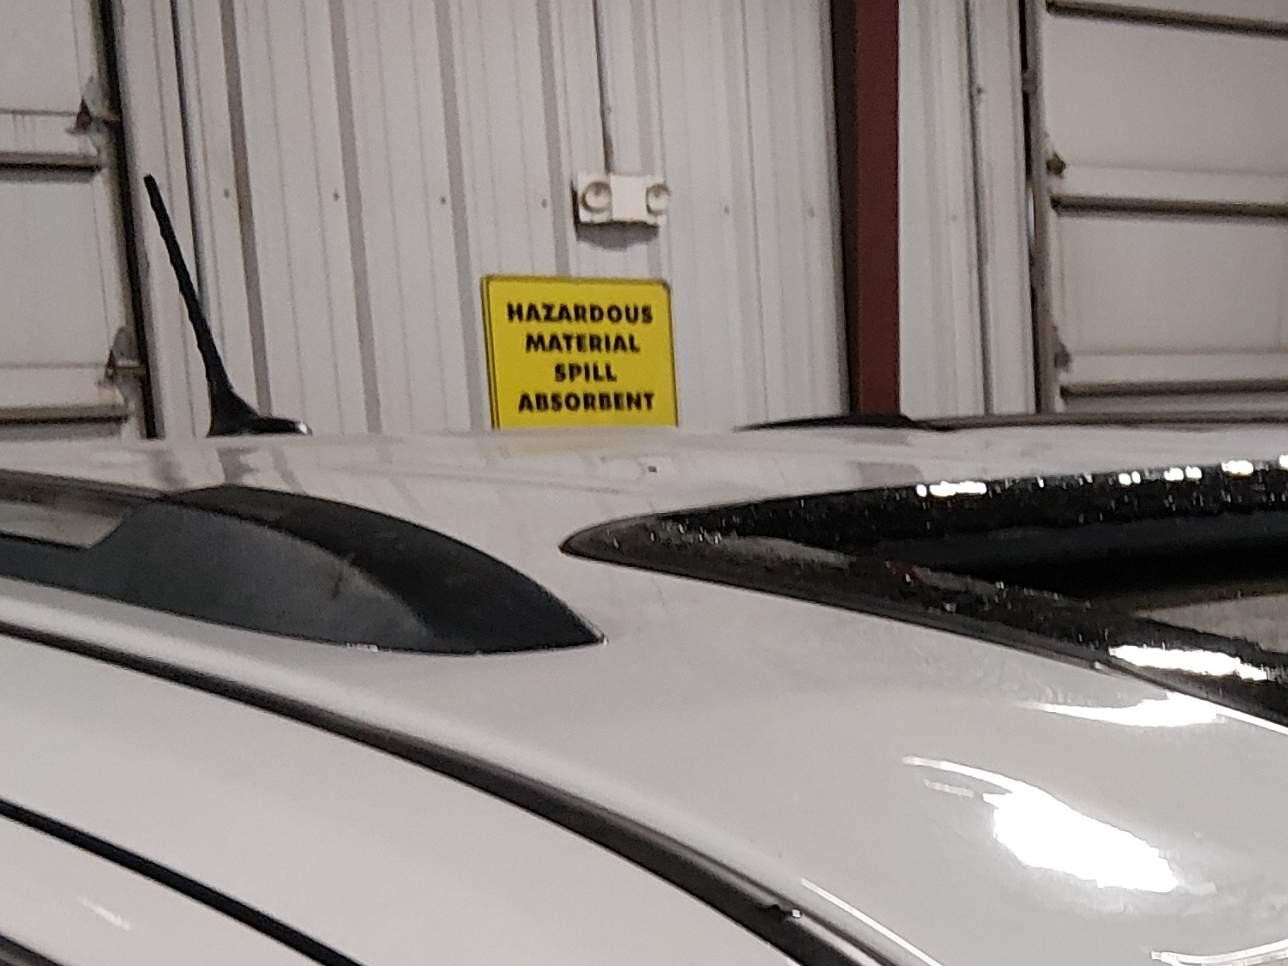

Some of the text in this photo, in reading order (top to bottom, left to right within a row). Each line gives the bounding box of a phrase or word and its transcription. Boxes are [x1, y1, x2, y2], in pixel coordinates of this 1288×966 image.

[507, 302, 653, 323] HAZARDOUS
[525, 332, 640, 353] MATERIAL
[554, 363, 617, 382] SPILL
[518, 391, 655, 413] ABSORBENT
